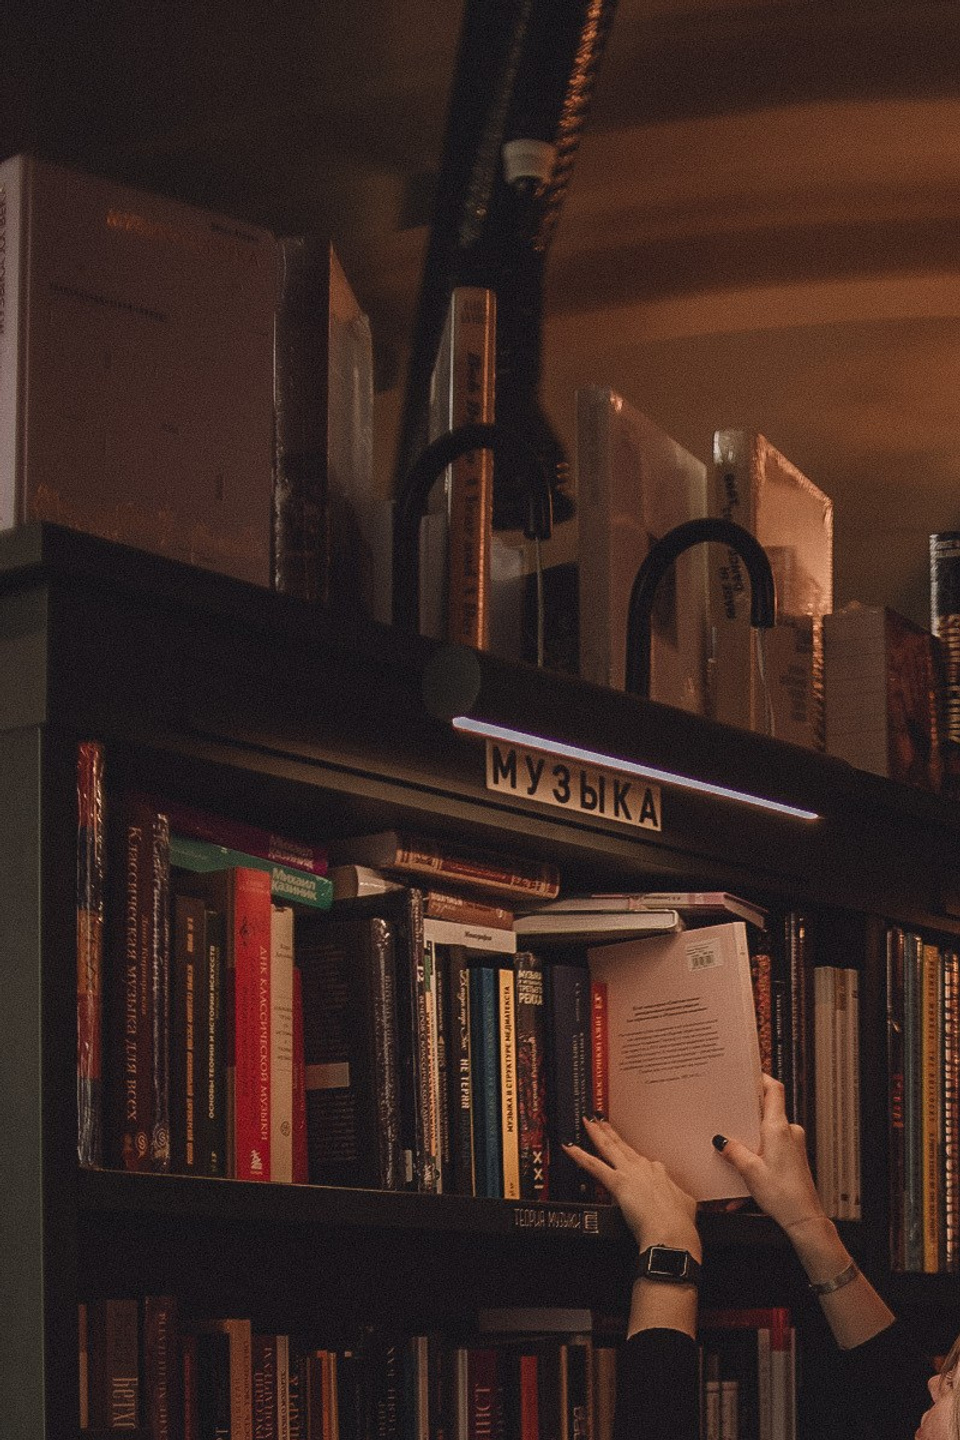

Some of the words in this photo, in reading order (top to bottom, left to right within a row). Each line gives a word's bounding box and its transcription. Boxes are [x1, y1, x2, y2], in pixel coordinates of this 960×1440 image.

[491, 745, 659, 827] МУЗЫКА
[126, 825, 144, 960] Классическая
[271, 880, 318, 901] Казиник
[272, 867, 316, 890] Михаил
[259, 944, 268, 975] ДНК
[121, 964, 140, 1035] музыка
[209, 992, 217, 1035] ИСТОРИИ
[418, 995, 426, 1033] ВЕЧЕРОВ
[503, 985, 512, 1042] МЕДИАТЕКСТА
[209, 1035, 216, 1043] И
[259, 977, 270, 1083] КЛАССИЧЕСКОЙ
[123, 1037, 139, 1074] для
[208, 1043, 216, 1078] ТЕОРИИ
[418, 1040, 429, 1108] КЛАССИЧЕСКОЙ
[460, 1058, 469, 1073] НЕ
[504, 1043, 513, 1089] СТРУКТУРЕ
[125, 1078, 139, 1123] всех
[208, 1079, 216, 1120] ОСНОВЫ
[259, 1084, 270, 1142] МУЗЫКИ
[506, 1097, 514, 1133] МУЗЫКА
[513, 1208, 545, 1228] ТЕОРИЯ
[547, 1210, 581, 1229] МУЗЫКИ
[288, 1374, 300, 1386] &
[253, 1371, 265, 1440] РУССКИЙ
